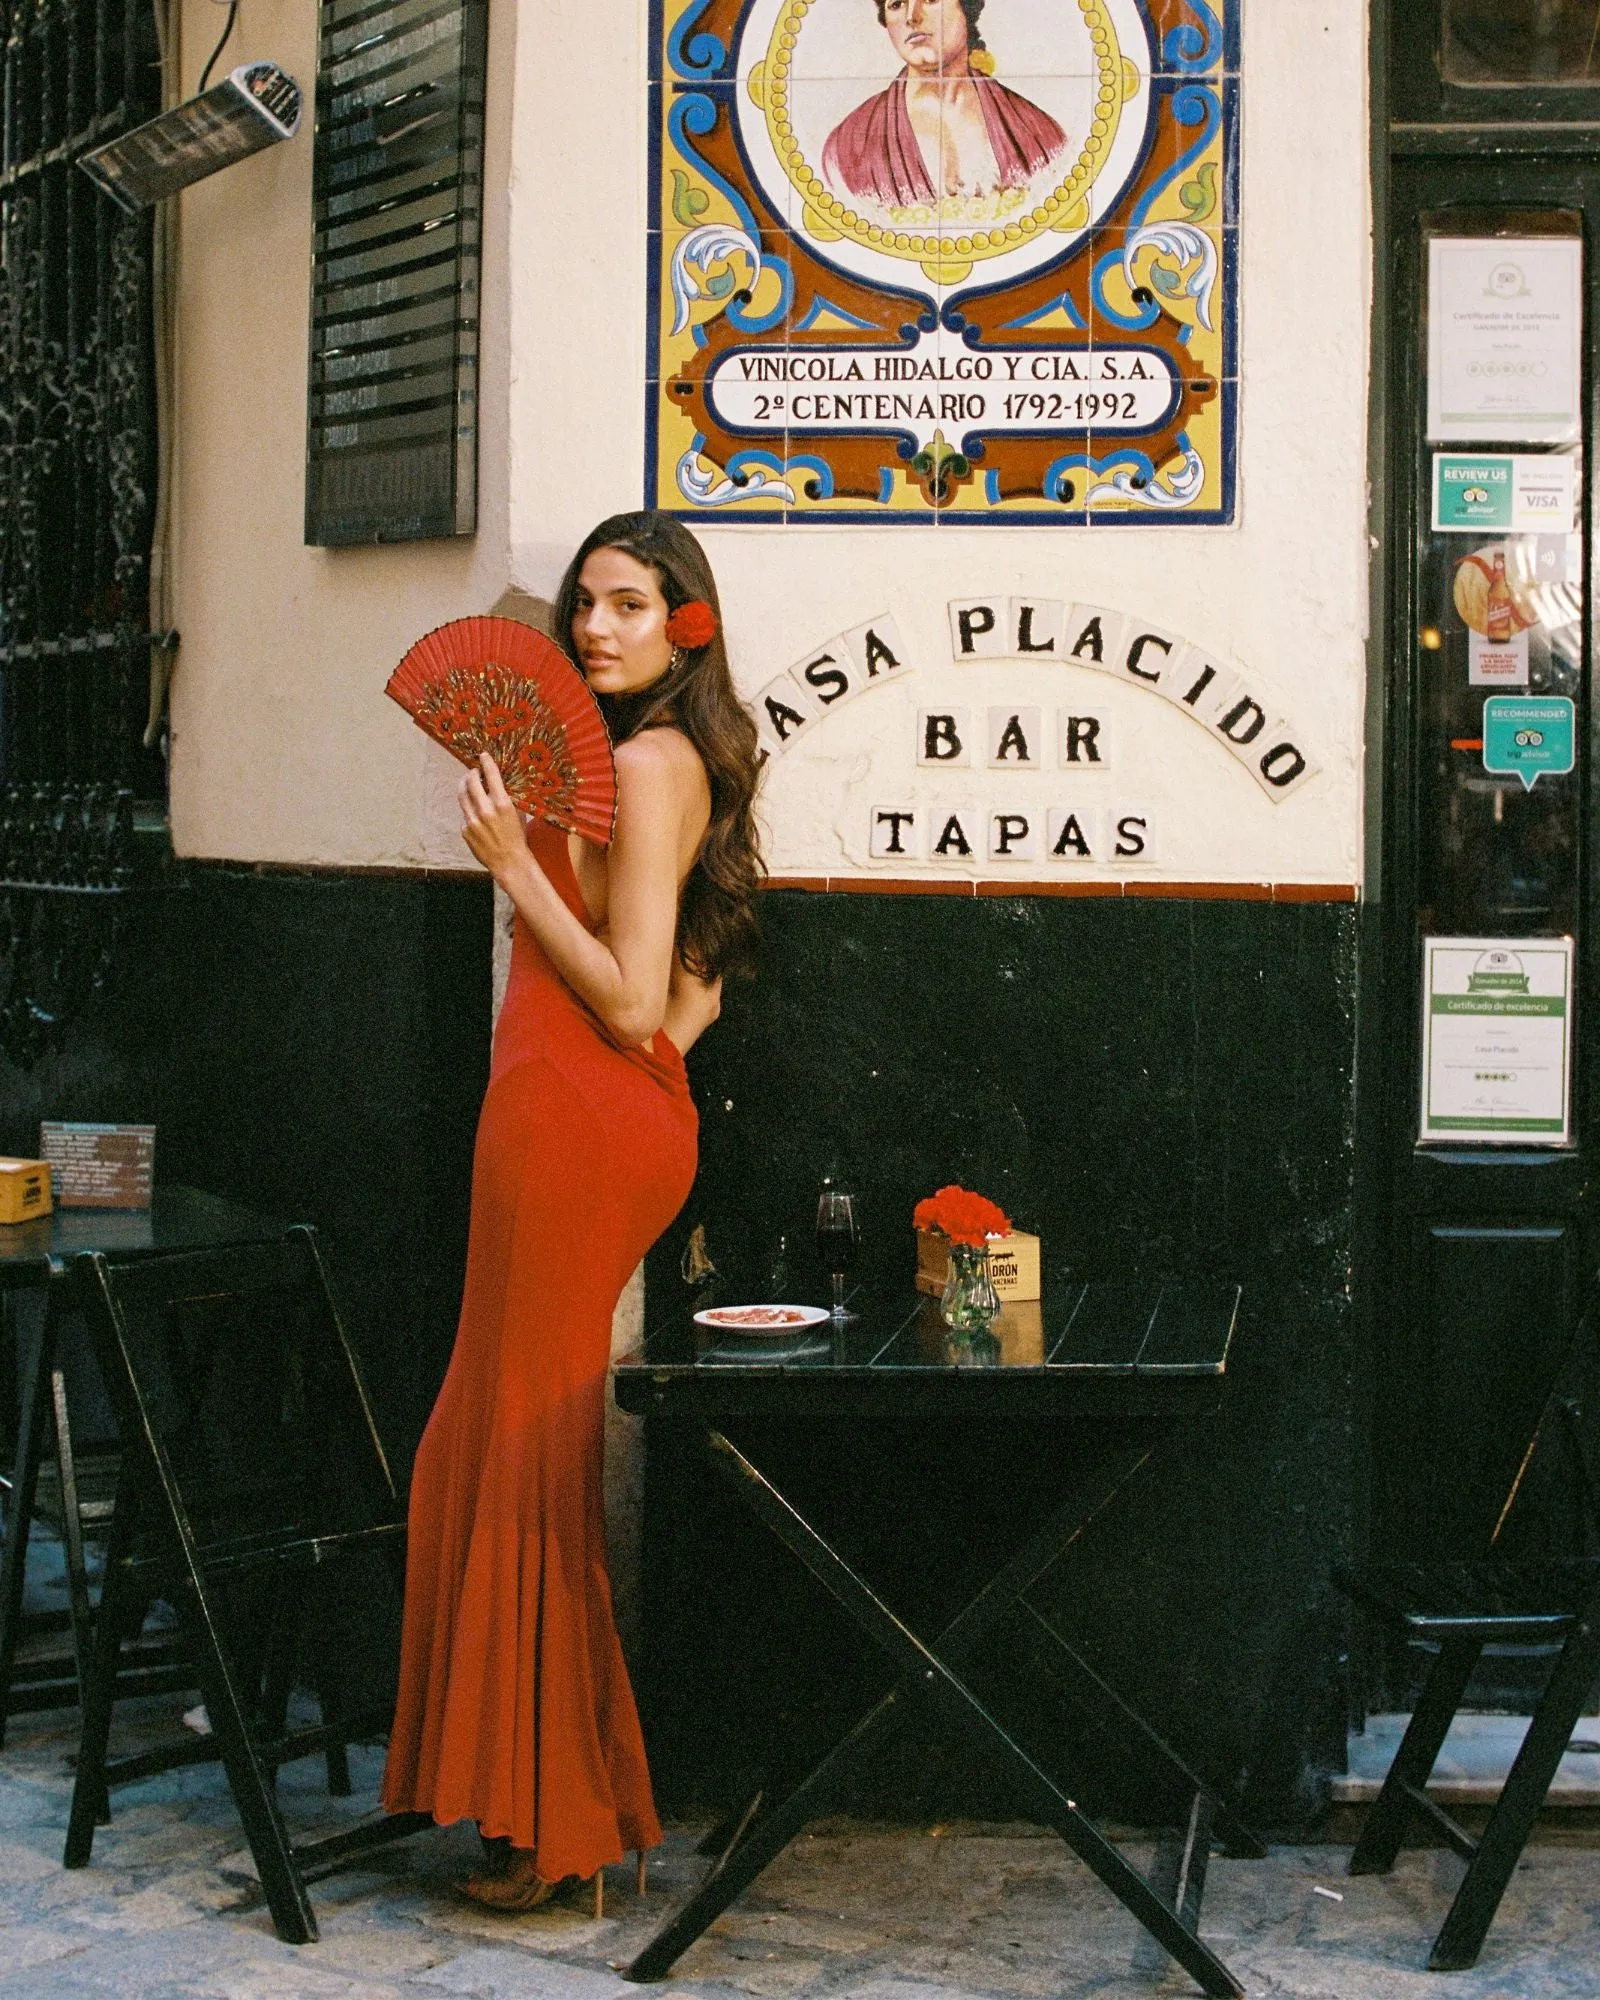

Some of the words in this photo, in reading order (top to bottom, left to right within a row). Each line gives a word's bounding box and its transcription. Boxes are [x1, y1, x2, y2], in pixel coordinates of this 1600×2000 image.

[739, 357, 862, 382] VINICOLA
[874, 356, 993, 381] HIDALGO
[1003, 357, 1021, 381] Y
[1030, 357, 1089, 381] CIA.
[1100, 357, 1156, 381] S.A.
[791, 393, 986, 422] CENTENARIO
[1002, 392, 1138, 421] 1792-1992
[1444, 469, 1489, 481] REVIEW
[1491, 469, 1507, 481] US
[1527, 495, 1559, 508] VISA
[757, 627, 902, 765] ASA
[957, 604, 1307, 788] PLACIDO
[1491, 709, 1568, 718] RECOMMENDED
[924, 713, 1103, 763] BAR
[876, 811, 1148, 857] TAPAS
[1447, 1001, 1493, 1010] Certificado
[1494, 1002, 1504, 1011] de
[1506, 1003, 1549, 1012] excelencia
